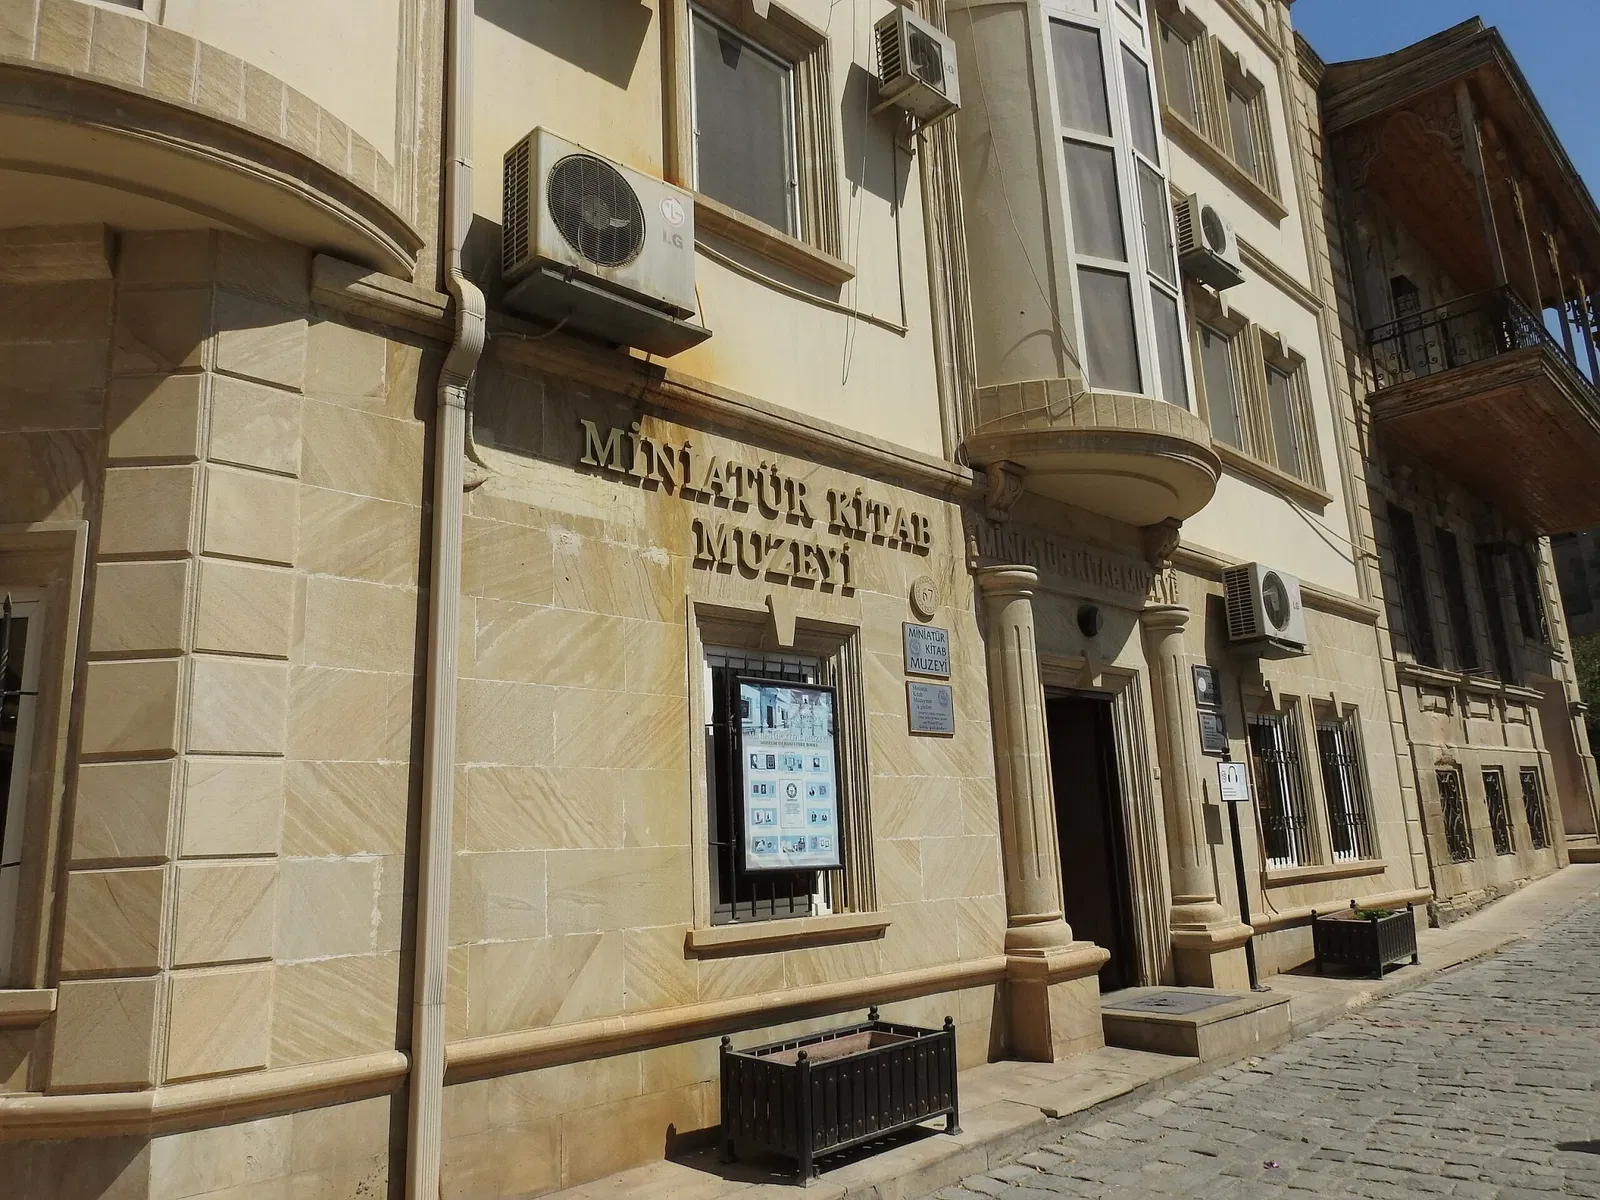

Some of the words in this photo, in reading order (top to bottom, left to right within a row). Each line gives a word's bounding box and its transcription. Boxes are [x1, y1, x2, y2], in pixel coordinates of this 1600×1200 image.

[662, 228, 684, 250] LG
[580, 418, 815, 518] MİNİATÜR
[829, 487, 935, 549] KİTAB
[693, 518, 852, 590] MUZEYİ
[922, 589, 934, 603] 67
[925, 642, 947, 656] KİTAB
[910, 656, 948, 672] MUZEYİ
